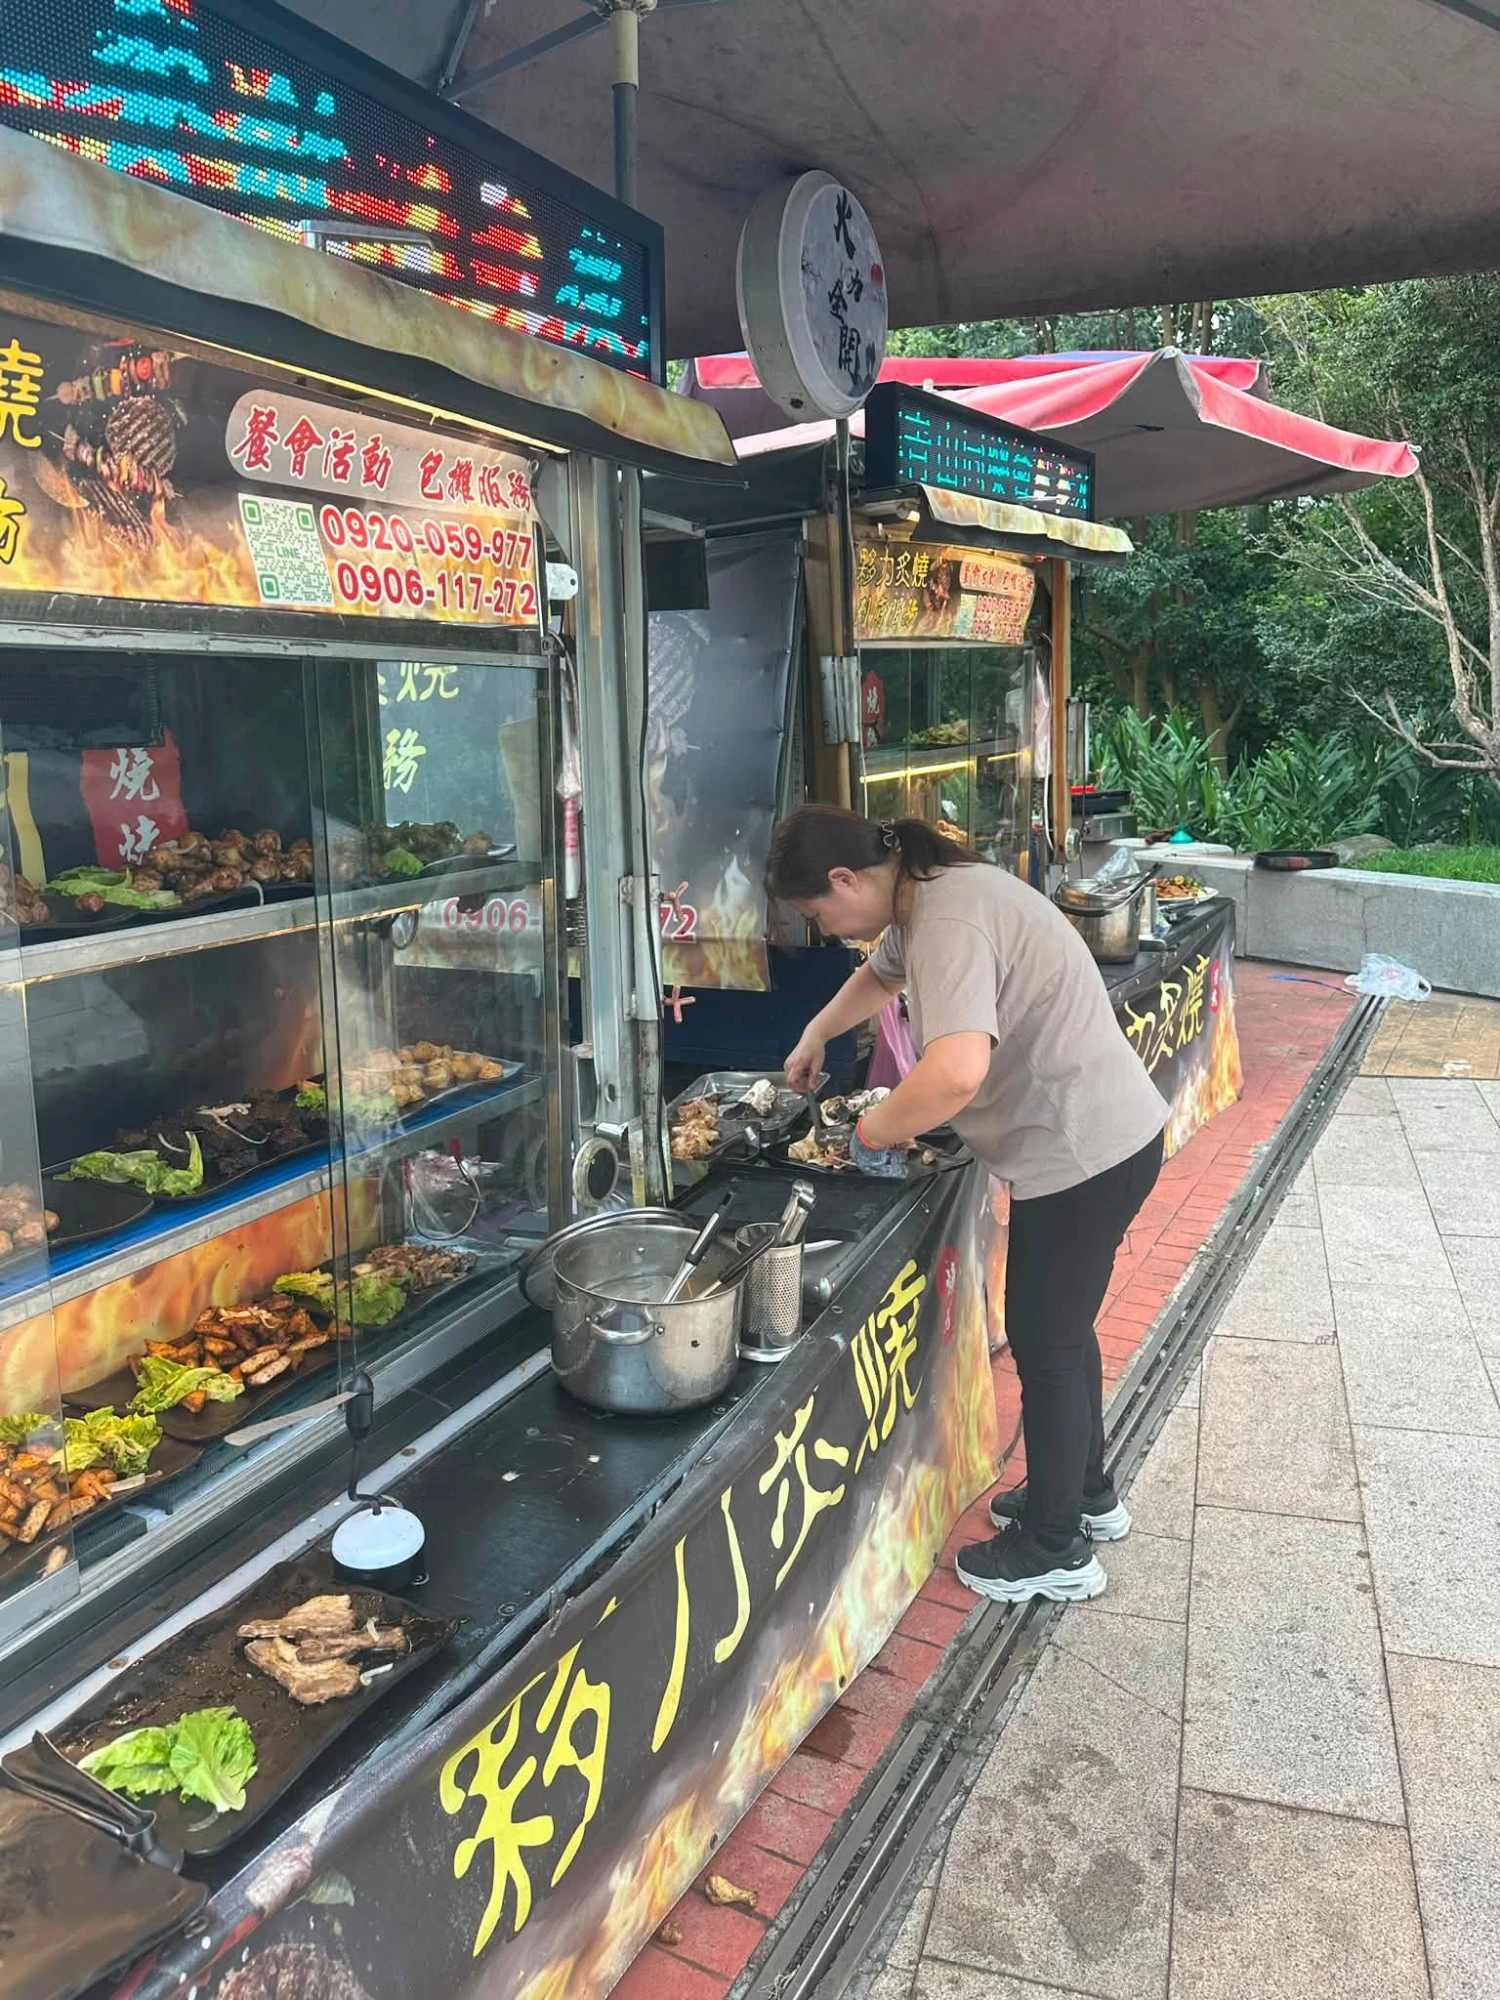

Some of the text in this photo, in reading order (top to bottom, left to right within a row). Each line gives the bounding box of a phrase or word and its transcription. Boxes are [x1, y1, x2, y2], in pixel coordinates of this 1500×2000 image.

[231, 405, 533, 515] 餐會活動 包攤服務
[320, 504, 533, 571] 0920-059-977
[336, 560, 538, 618] 0906-117-272
